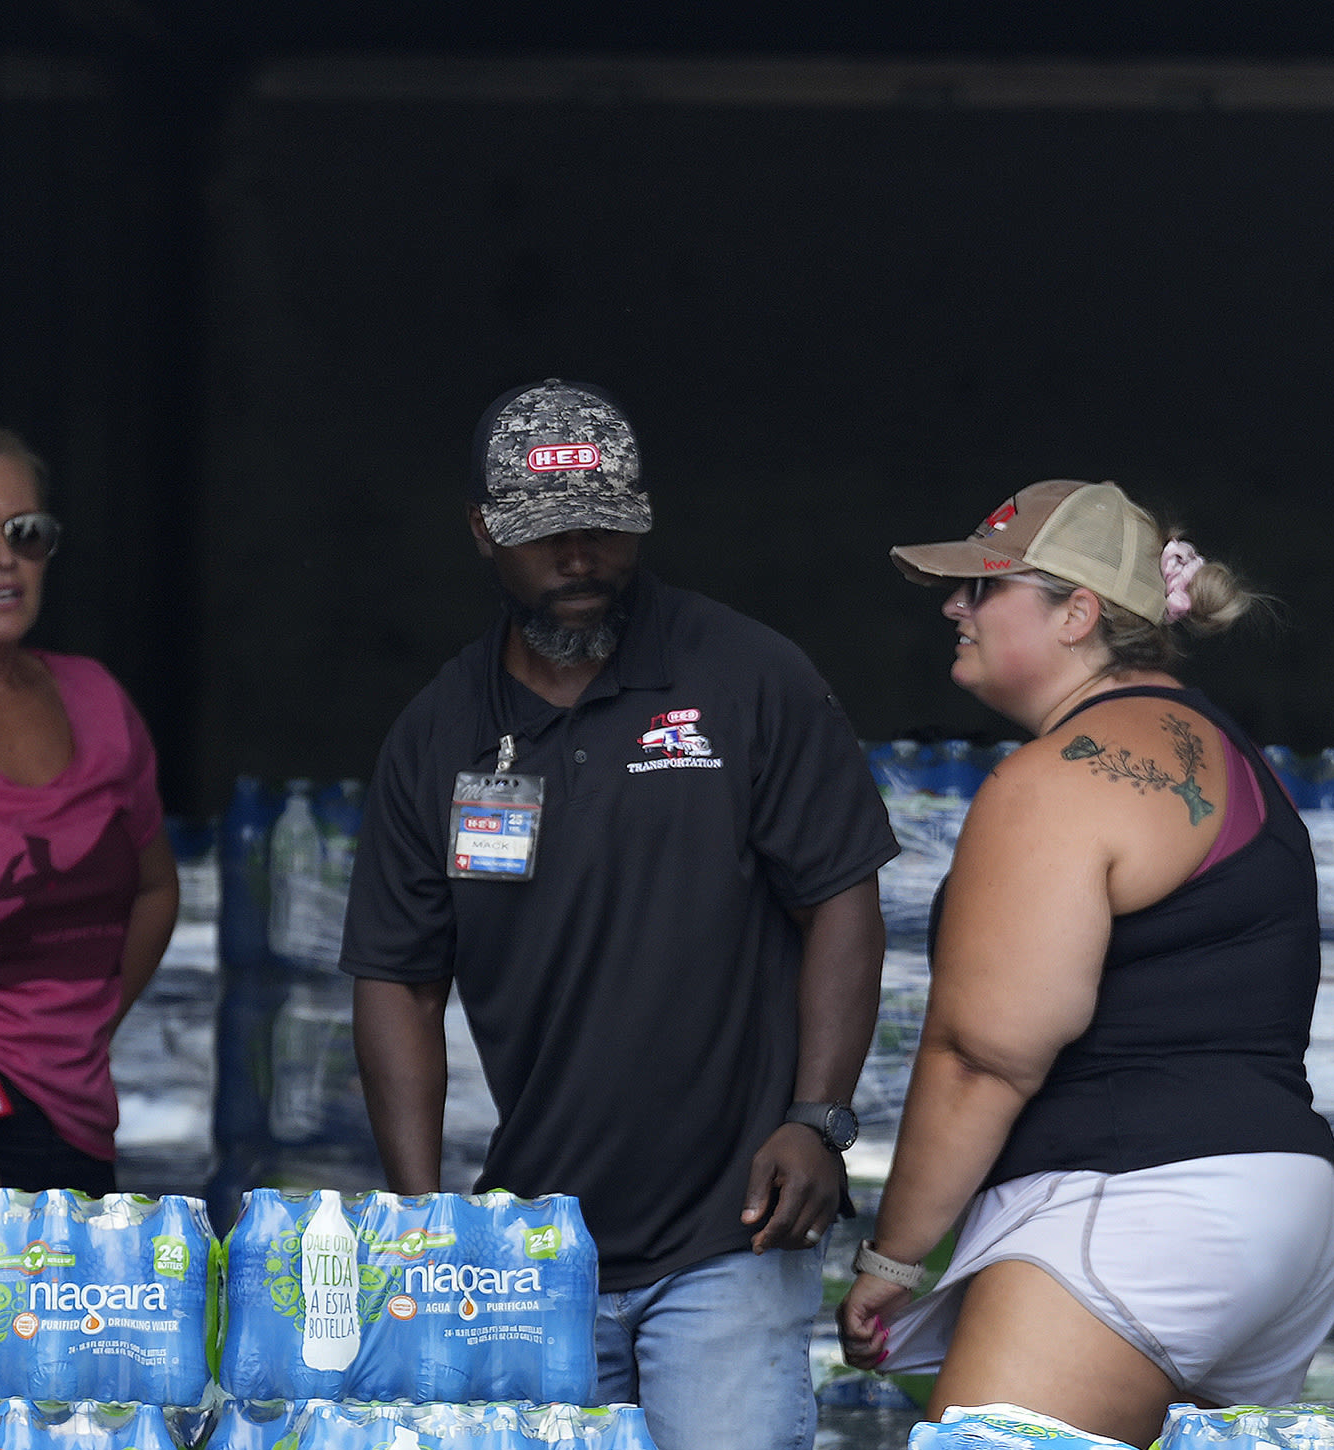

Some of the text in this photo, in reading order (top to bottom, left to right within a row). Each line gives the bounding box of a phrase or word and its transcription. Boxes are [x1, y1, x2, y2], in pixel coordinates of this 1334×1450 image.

[535, 449, 593, 466] H-E-B
[983, 558, 1011, 571] kw
[627, 757, 723, 774] TRANSPORTATION
[508, 814, 523, 825] 25
[472, 841, 509, 850] MACK
[306, 1233, 353, 1254] DALE OTRA
[530, 1229, 555, 1247] 24
[157, 1245, 184, 1262] 24
[157, 1261, 184, 1271] BOTTLES
[307, 1255, 352, 1288] VIDA
[405, 1260, 541, 1320] niagara
[29, 1277, 167, 1335] niagara
[310, 1289, 352, 1314] A ÉSTA
[425, 1300, 539, 1313] AGUA PURIFICADA
[41, 1318, 178, 1332] PURIFIED DRINKING WATER
[308, 1316, 355, 1340] BOTELLA
